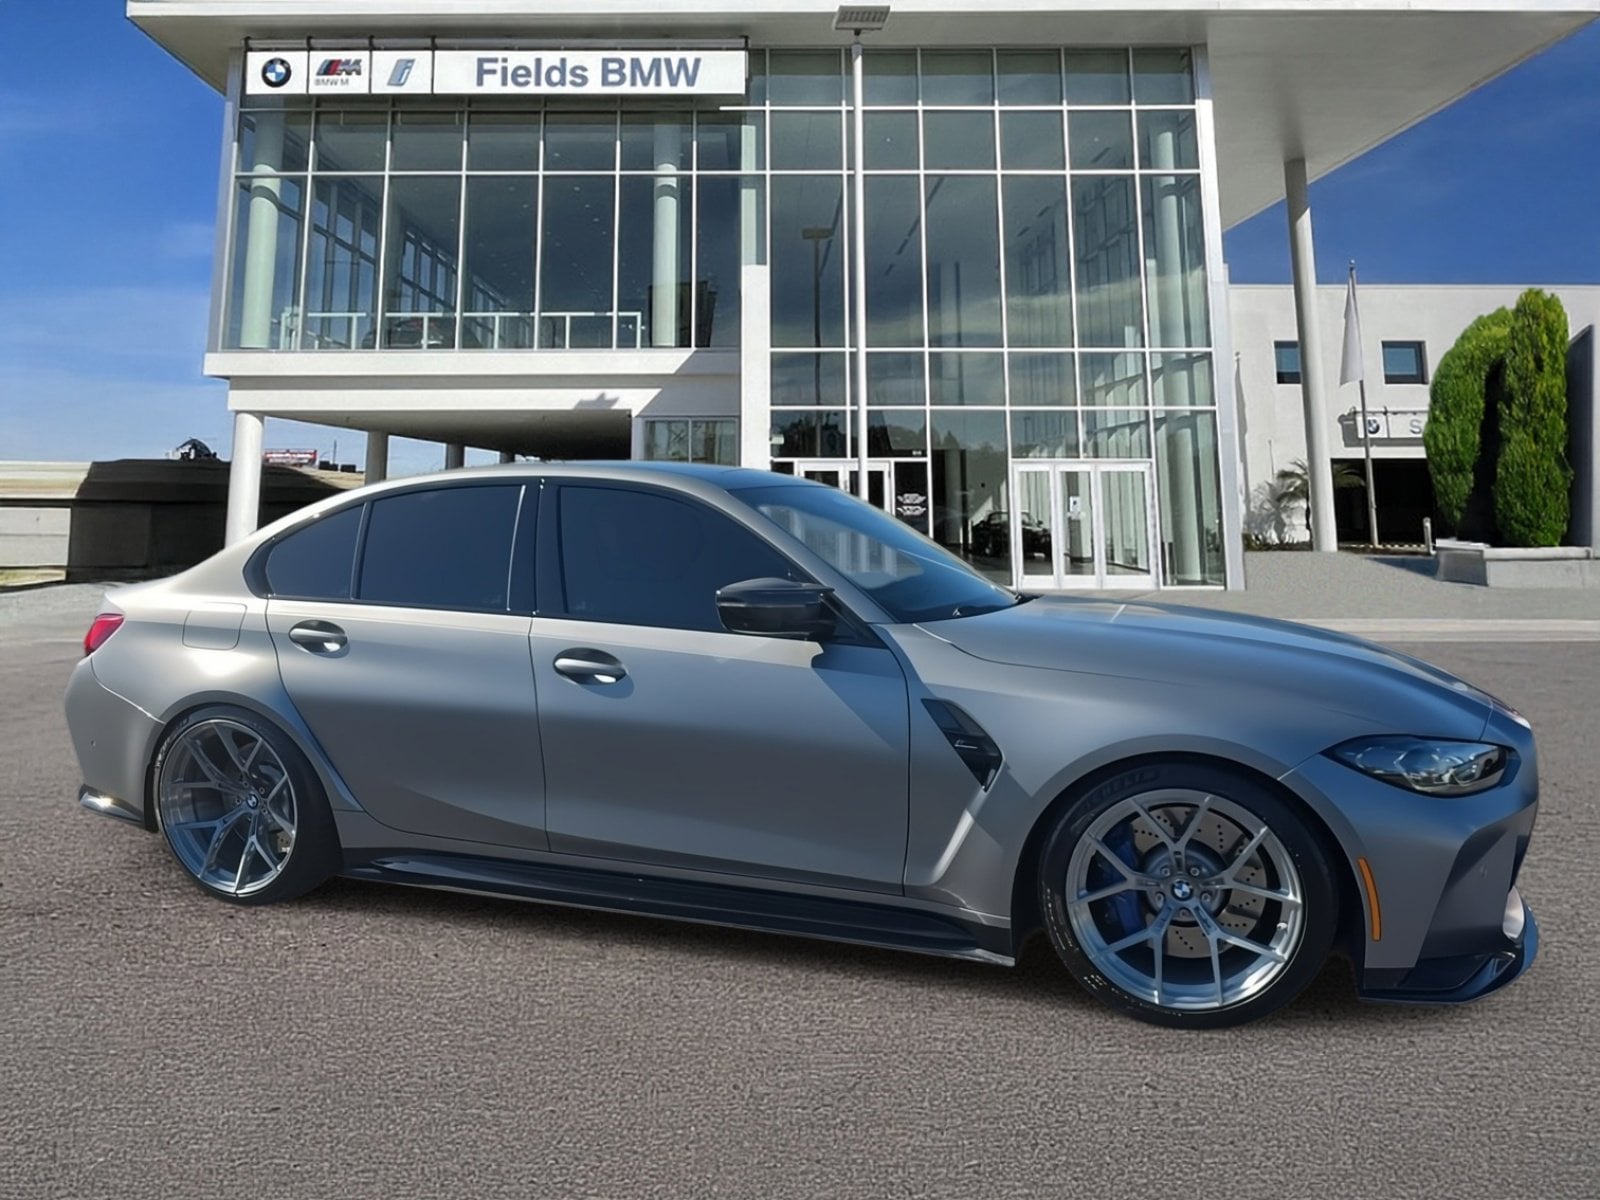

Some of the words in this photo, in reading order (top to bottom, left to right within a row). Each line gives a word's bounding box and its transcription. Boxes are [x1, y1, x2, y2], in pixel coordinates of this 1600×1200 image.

[476, 57, 589, 87] Fields
[601, 57, 702, 87] BMW
[314, 78, 339, 86] BMW
[340, 78, 349, 86] M
[1409, 419, 1423, 434] S
